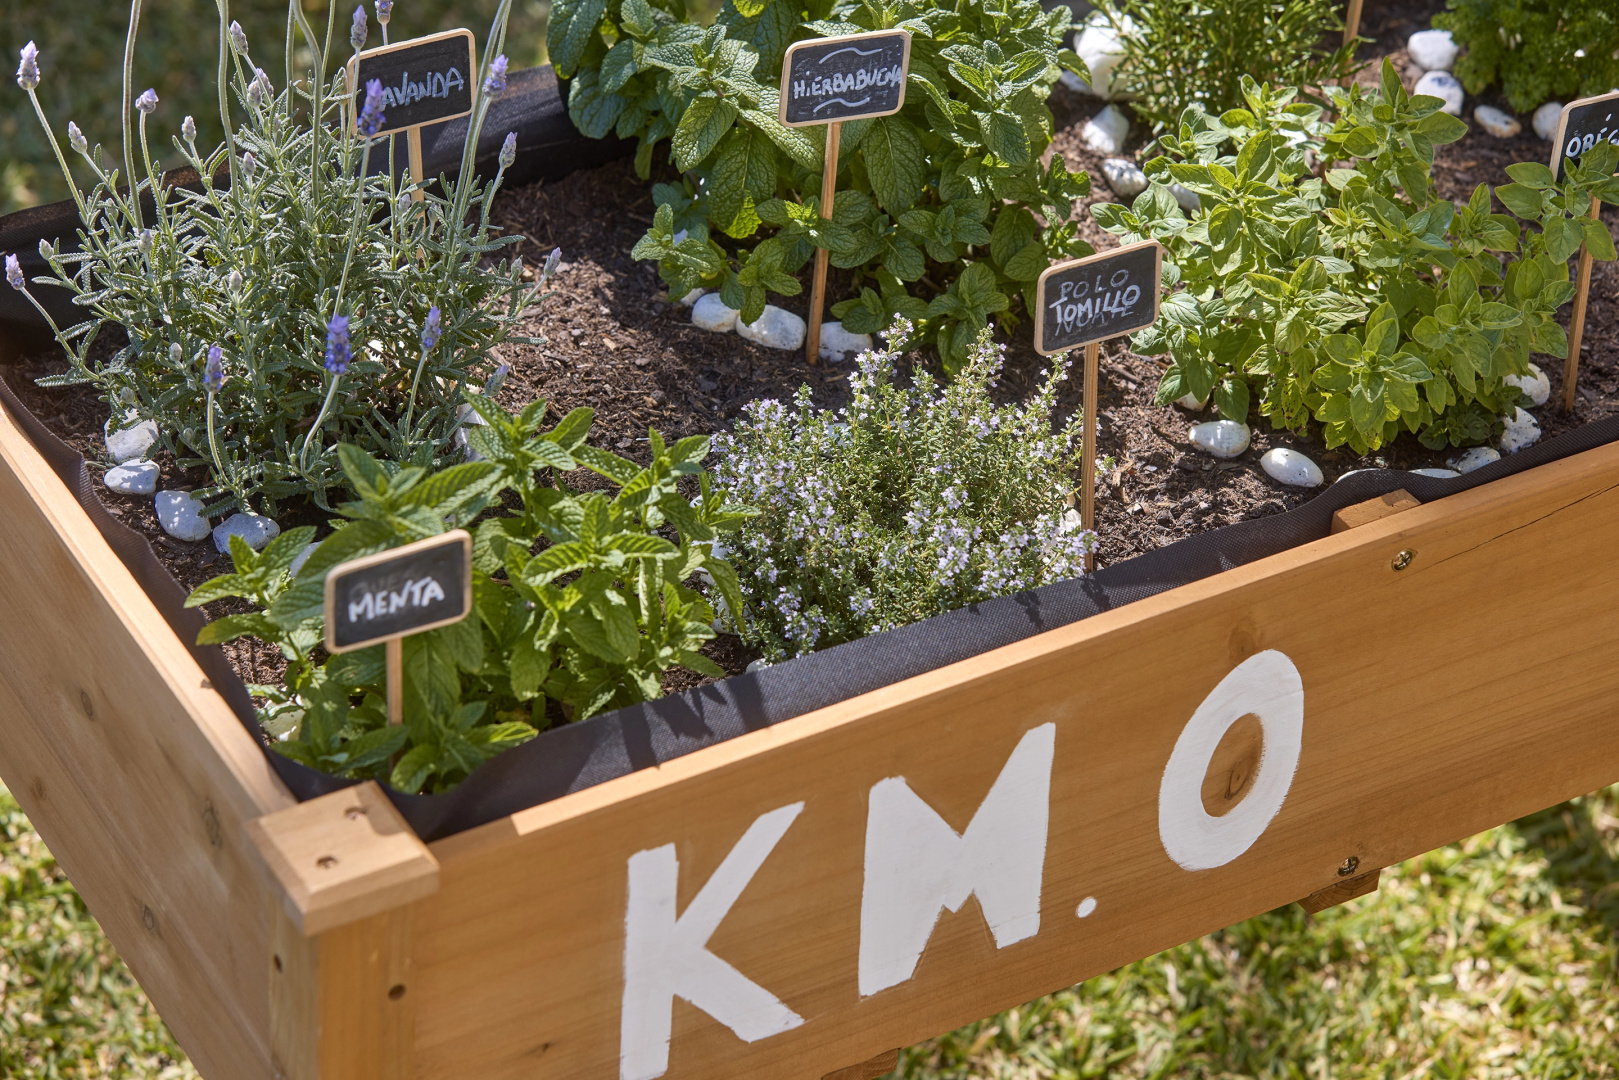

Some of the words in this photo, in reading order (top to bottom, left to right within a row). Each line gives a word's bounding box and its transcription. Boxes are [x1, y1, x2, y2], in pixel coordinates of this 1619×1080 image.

[368, 67, 464, 112] AVANDA
[1049, 284, 1141, 324] TOMILLO
[1059, 269, 1129, 299] POLO
[348, 576, 445, 623] MENTA
